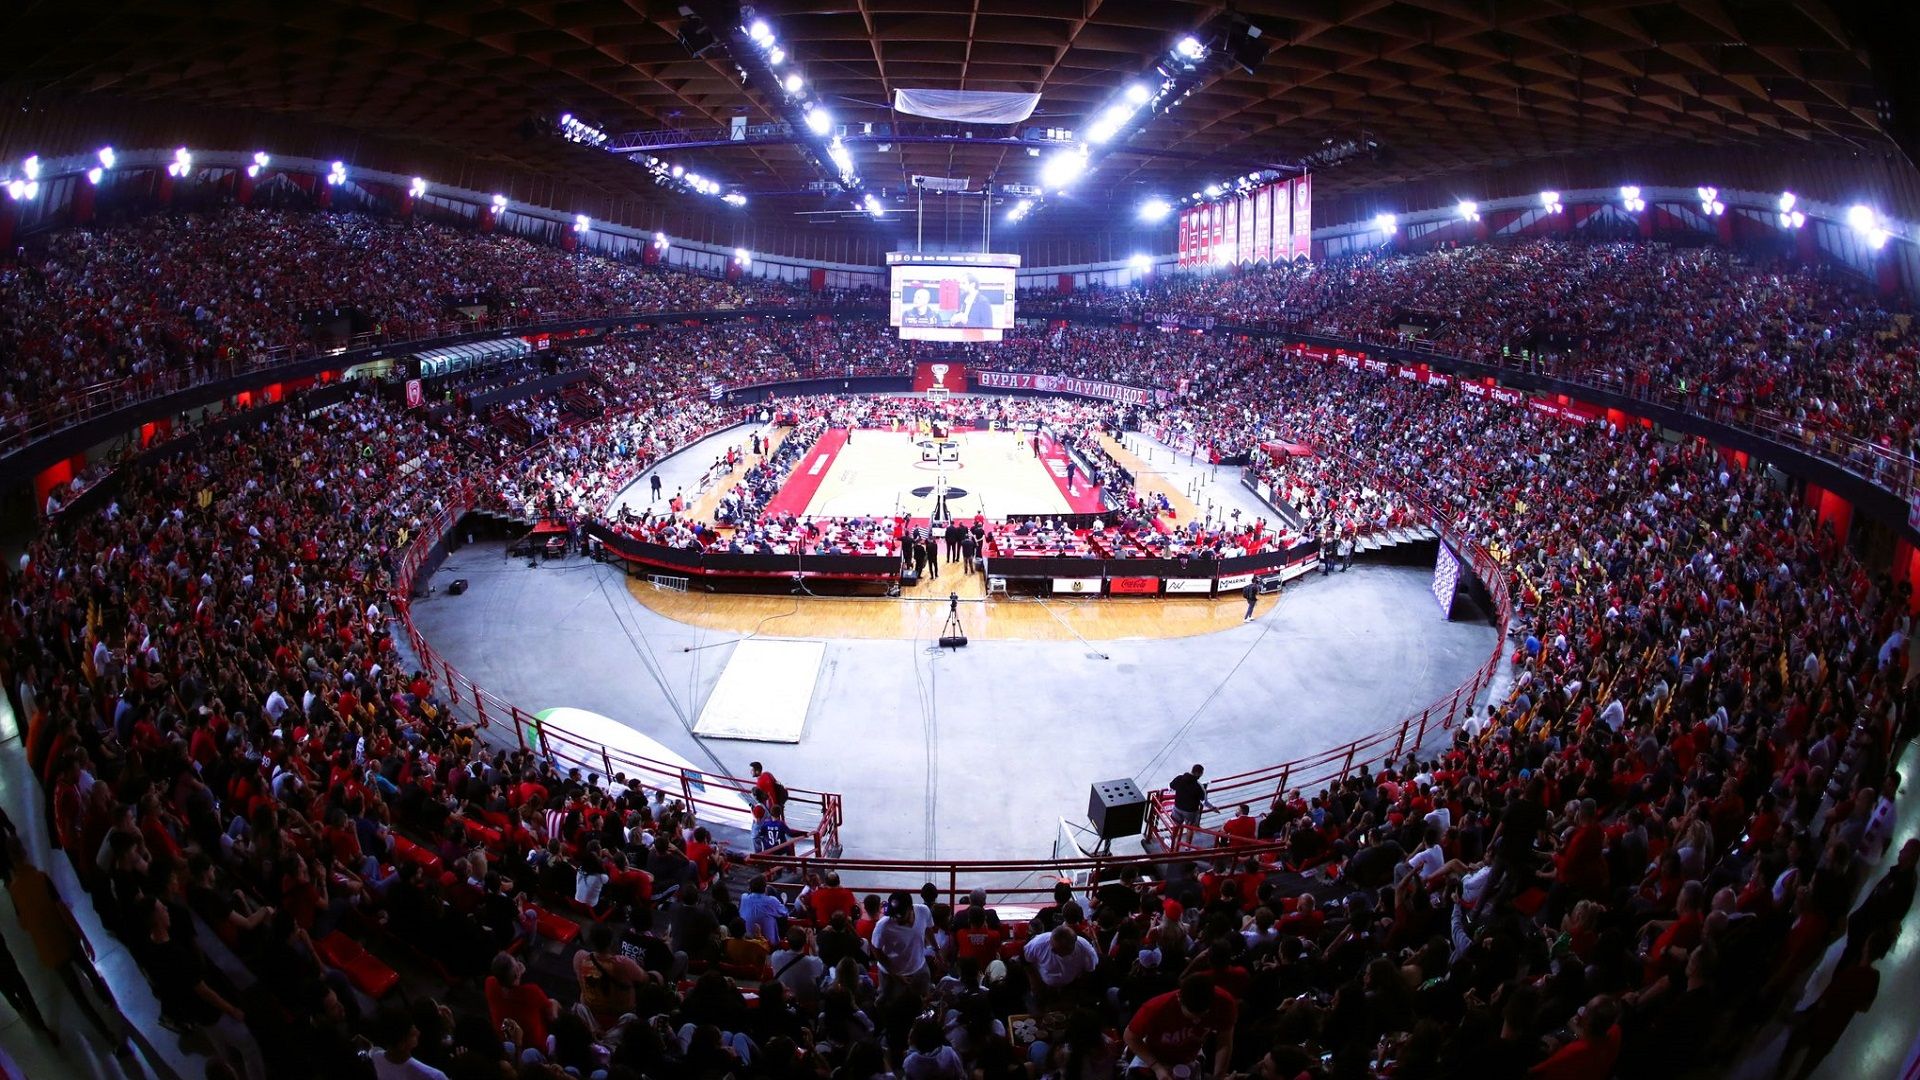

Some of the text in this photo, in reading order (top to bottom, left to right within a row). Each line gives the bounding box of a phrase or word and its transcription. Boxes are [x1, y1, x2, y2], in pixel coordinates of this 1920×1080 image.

[981, 373, 1031, 387] ΘΥΡΑ 7
[1399, 366, 1416, 380] bwin
[1428, 373, 1448, 388] bwin
[1066, 379, 1144, 404] ΟΛΥΜΠΙΑΚΟΣ
[1228, 577, 1247, 586] MARINE
[621, 940, 647, 957] RECK
